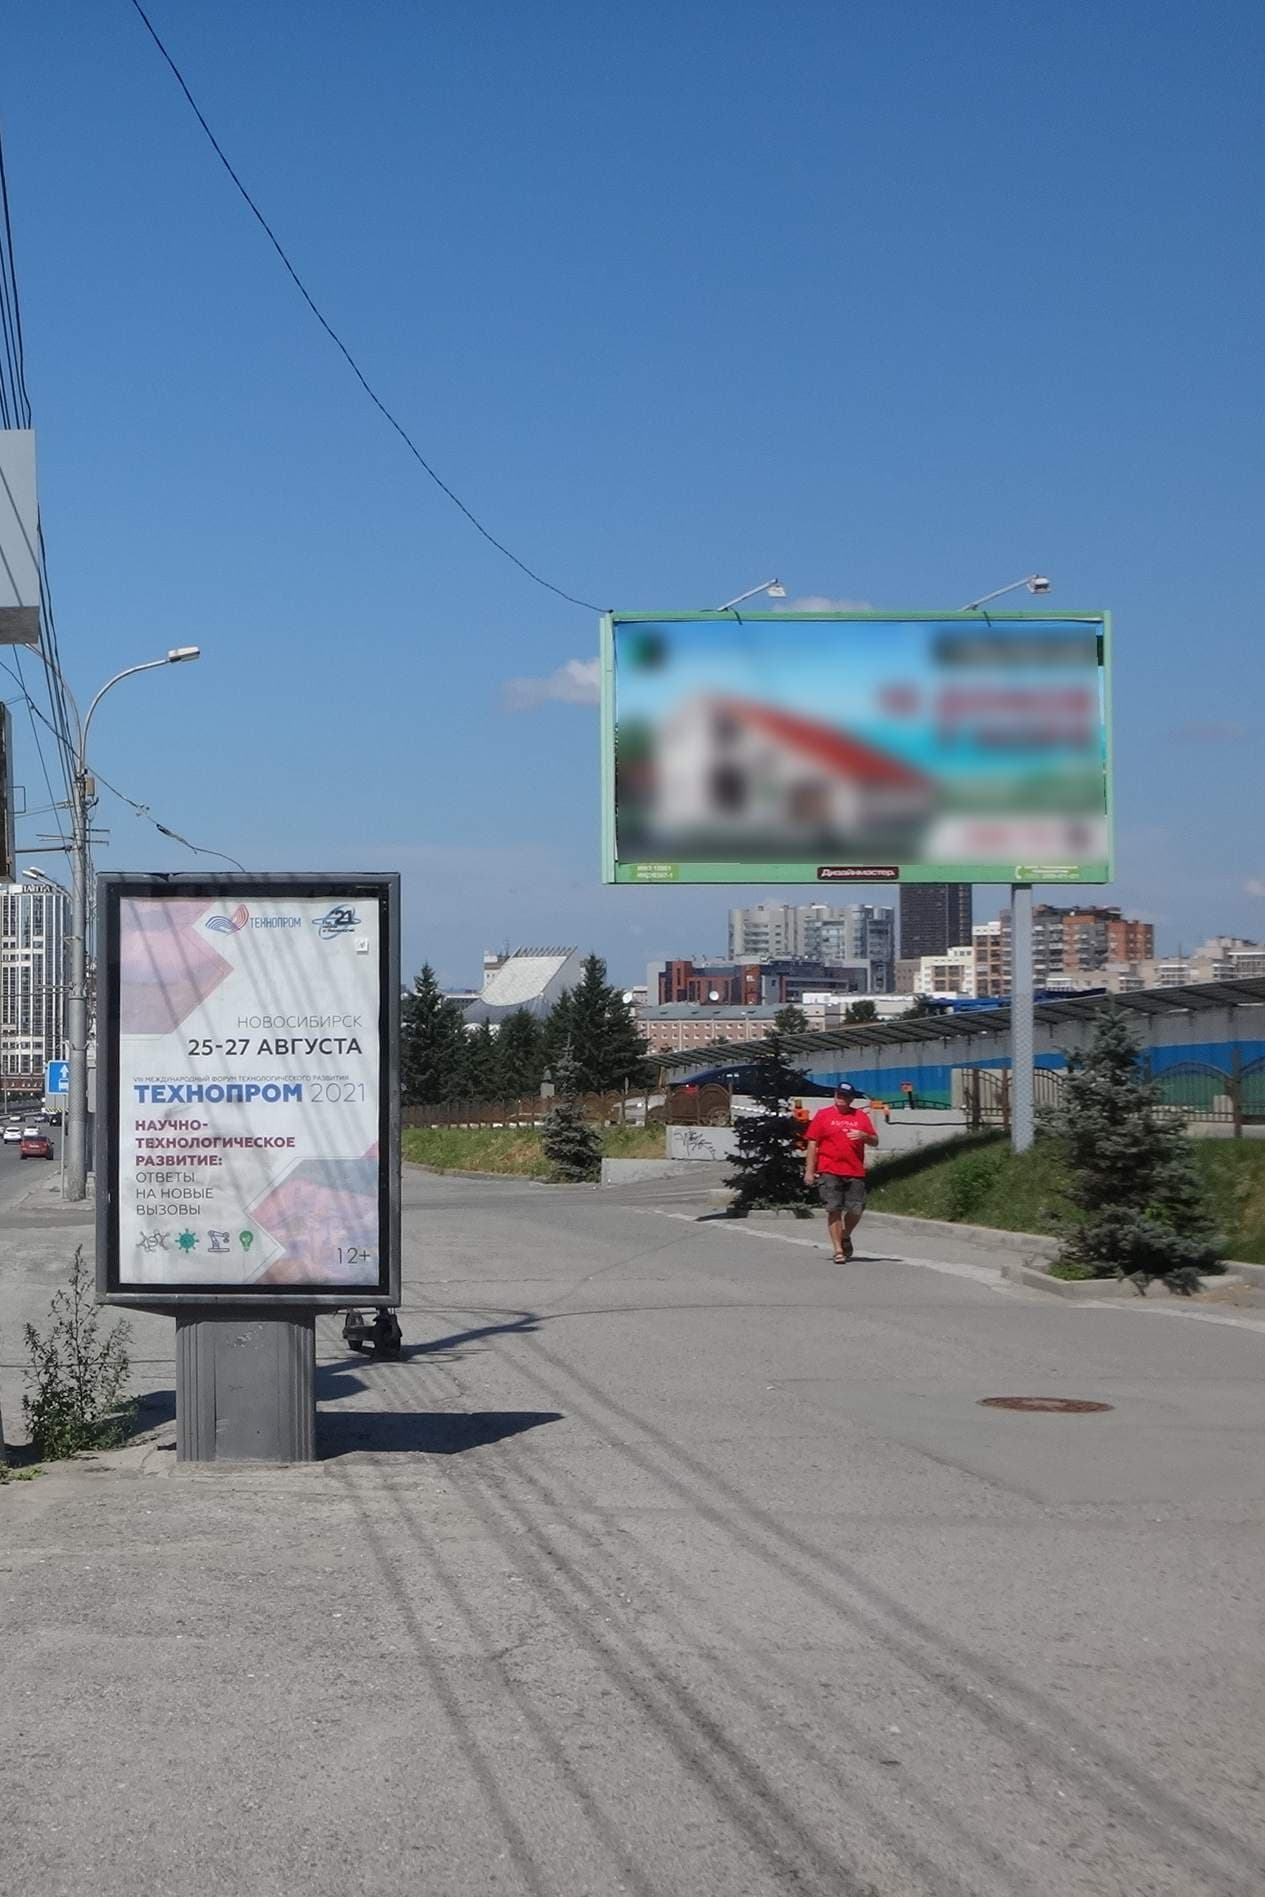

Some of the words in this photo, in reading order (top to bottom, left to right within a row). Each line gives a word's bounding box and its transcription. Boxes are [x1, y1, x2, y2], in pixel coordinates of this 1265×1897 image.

[237, 1015, 363, 1028] НОВОСИБИРСК
[187, 1038, 250, 1056] 25-27
[257, 1037, 363, 1055] АВГУСТА
[133, 1084, 303, 1103] ТЕХНОПРОМ
[310, 1082, 366, 1103] 2021
[135, 1120, 208, 1131] НАУЧНО-
[135, 1136, 296, 1149] ТЕХНОЛОГИЧЕСКОЕ
[135, 1155, 223, 1166] РАЗВИТИЕ:
[136, 1171, 195, 1183] ОТВЕТЫ
[136, 1188, 157, 1199] НА
[160, 1187, 214, 1199] НОВЫЕ
[136, 1204, 201, 1216] ВЫЗОВЫ
[337, 1247, 371, 1264] 12+
